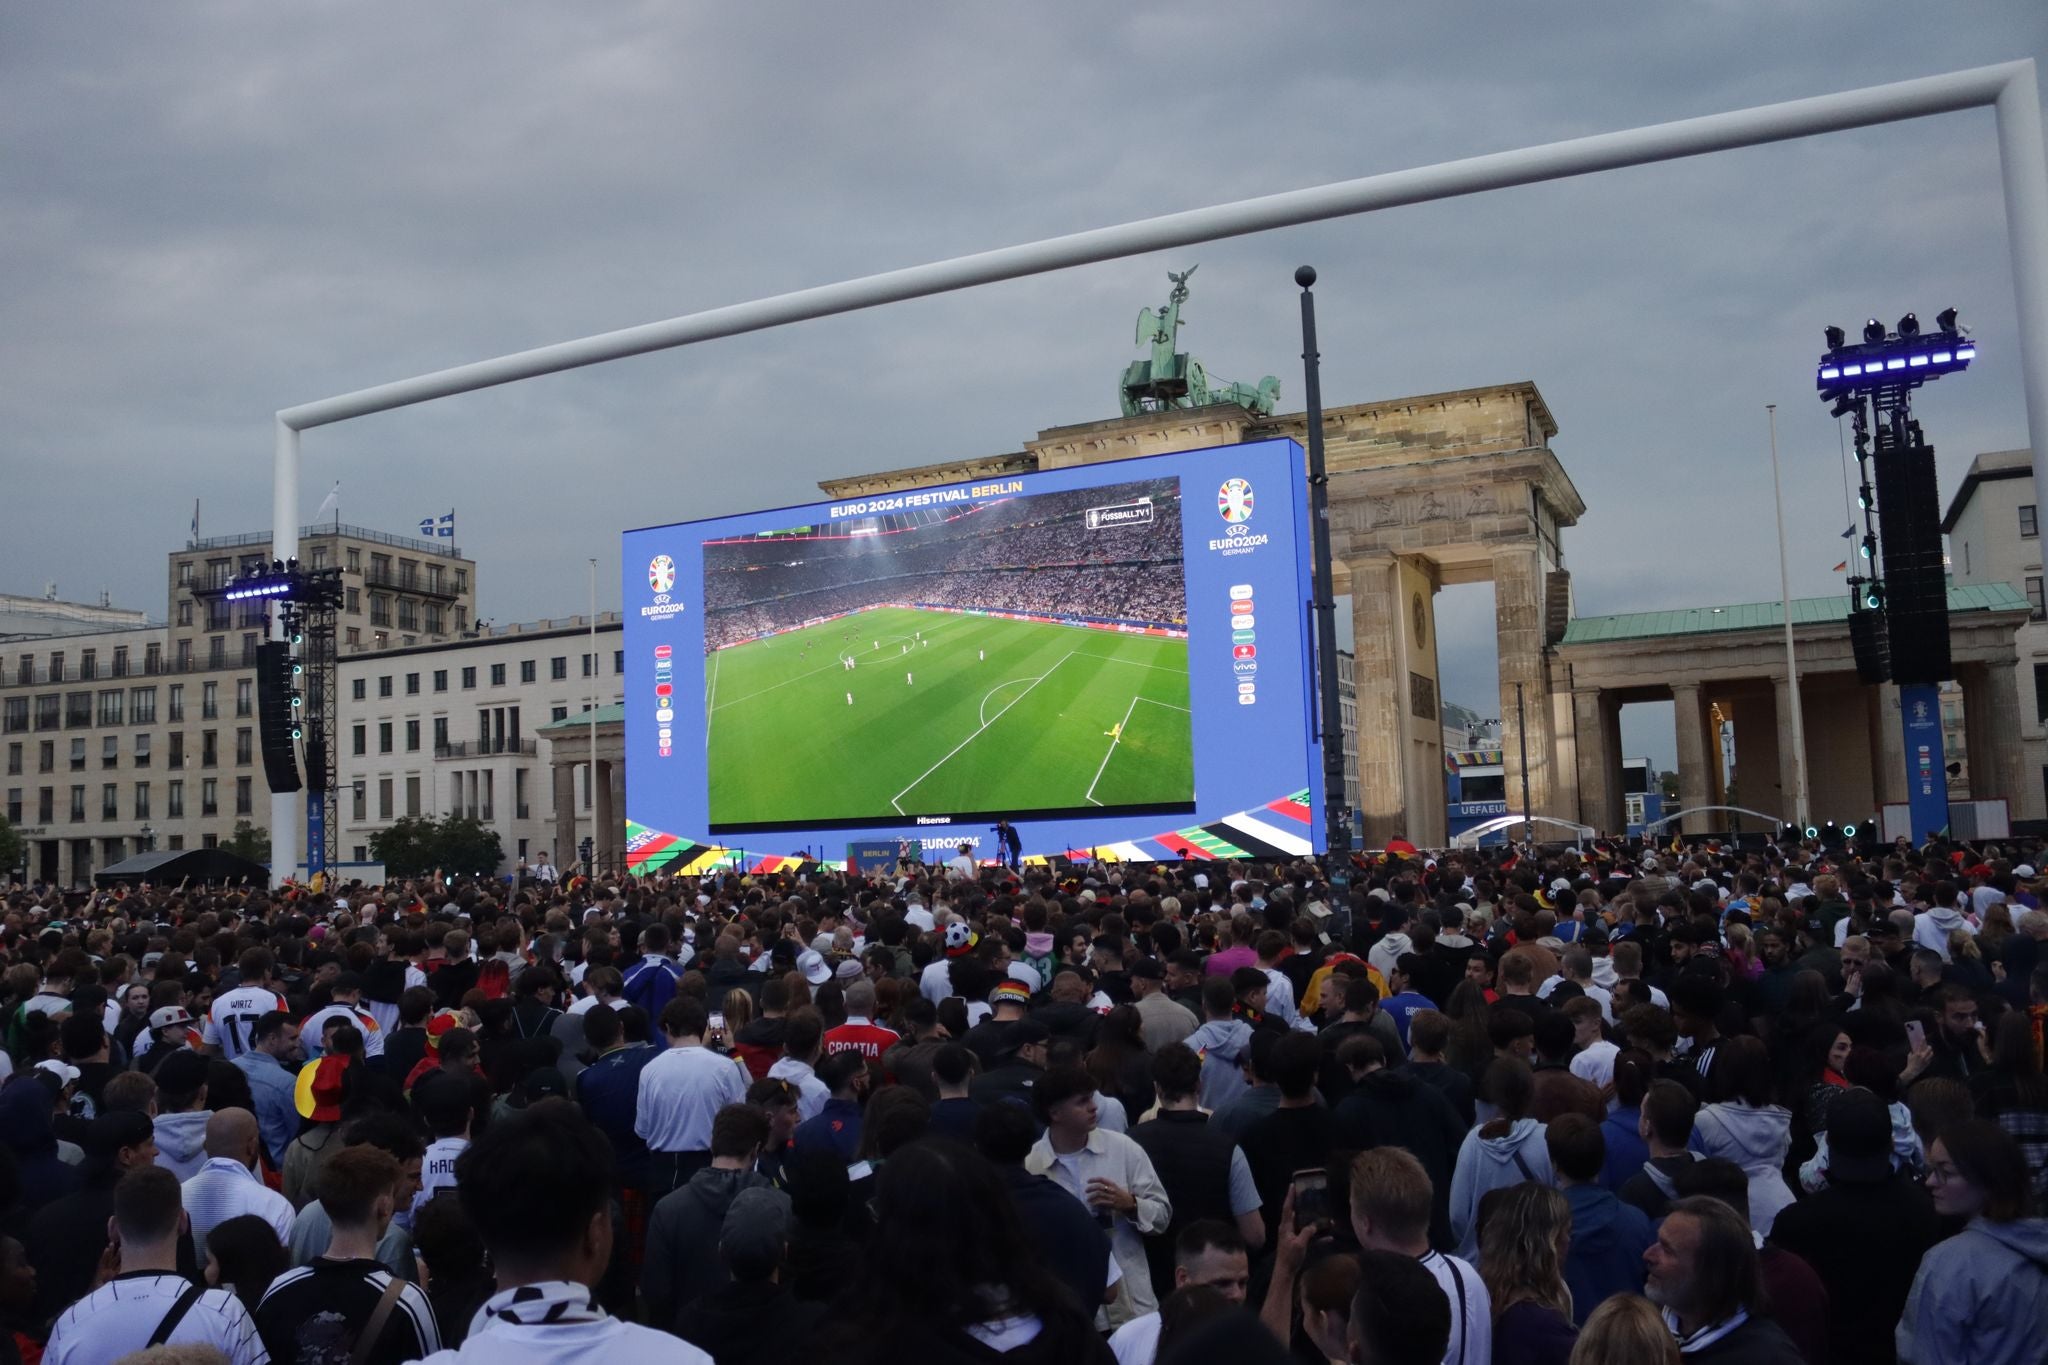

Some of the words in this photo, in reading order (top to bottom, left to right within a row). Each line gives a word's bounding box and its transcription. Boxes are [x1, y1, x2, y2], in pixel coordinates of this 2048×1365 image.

[831, 501, 866, 518] EURO
[869, 498, 904, 512] 2024
[906, 489, 968, 508] FESTIVAL
[972, 481, 1022, 498] BERLIN
[1209, 535, 1268, 550] EURO2024
[1222, 547, 1254, 556] GERMANY
[641, 603, 684, 616] EURO2024
[917, 817, 951, 825] Hisense
[230, 1000, 253, 1009] WIRTZ
[223, 1014, 259, 1054] 17
[828, 1041, 879, 1057] CROATIA
